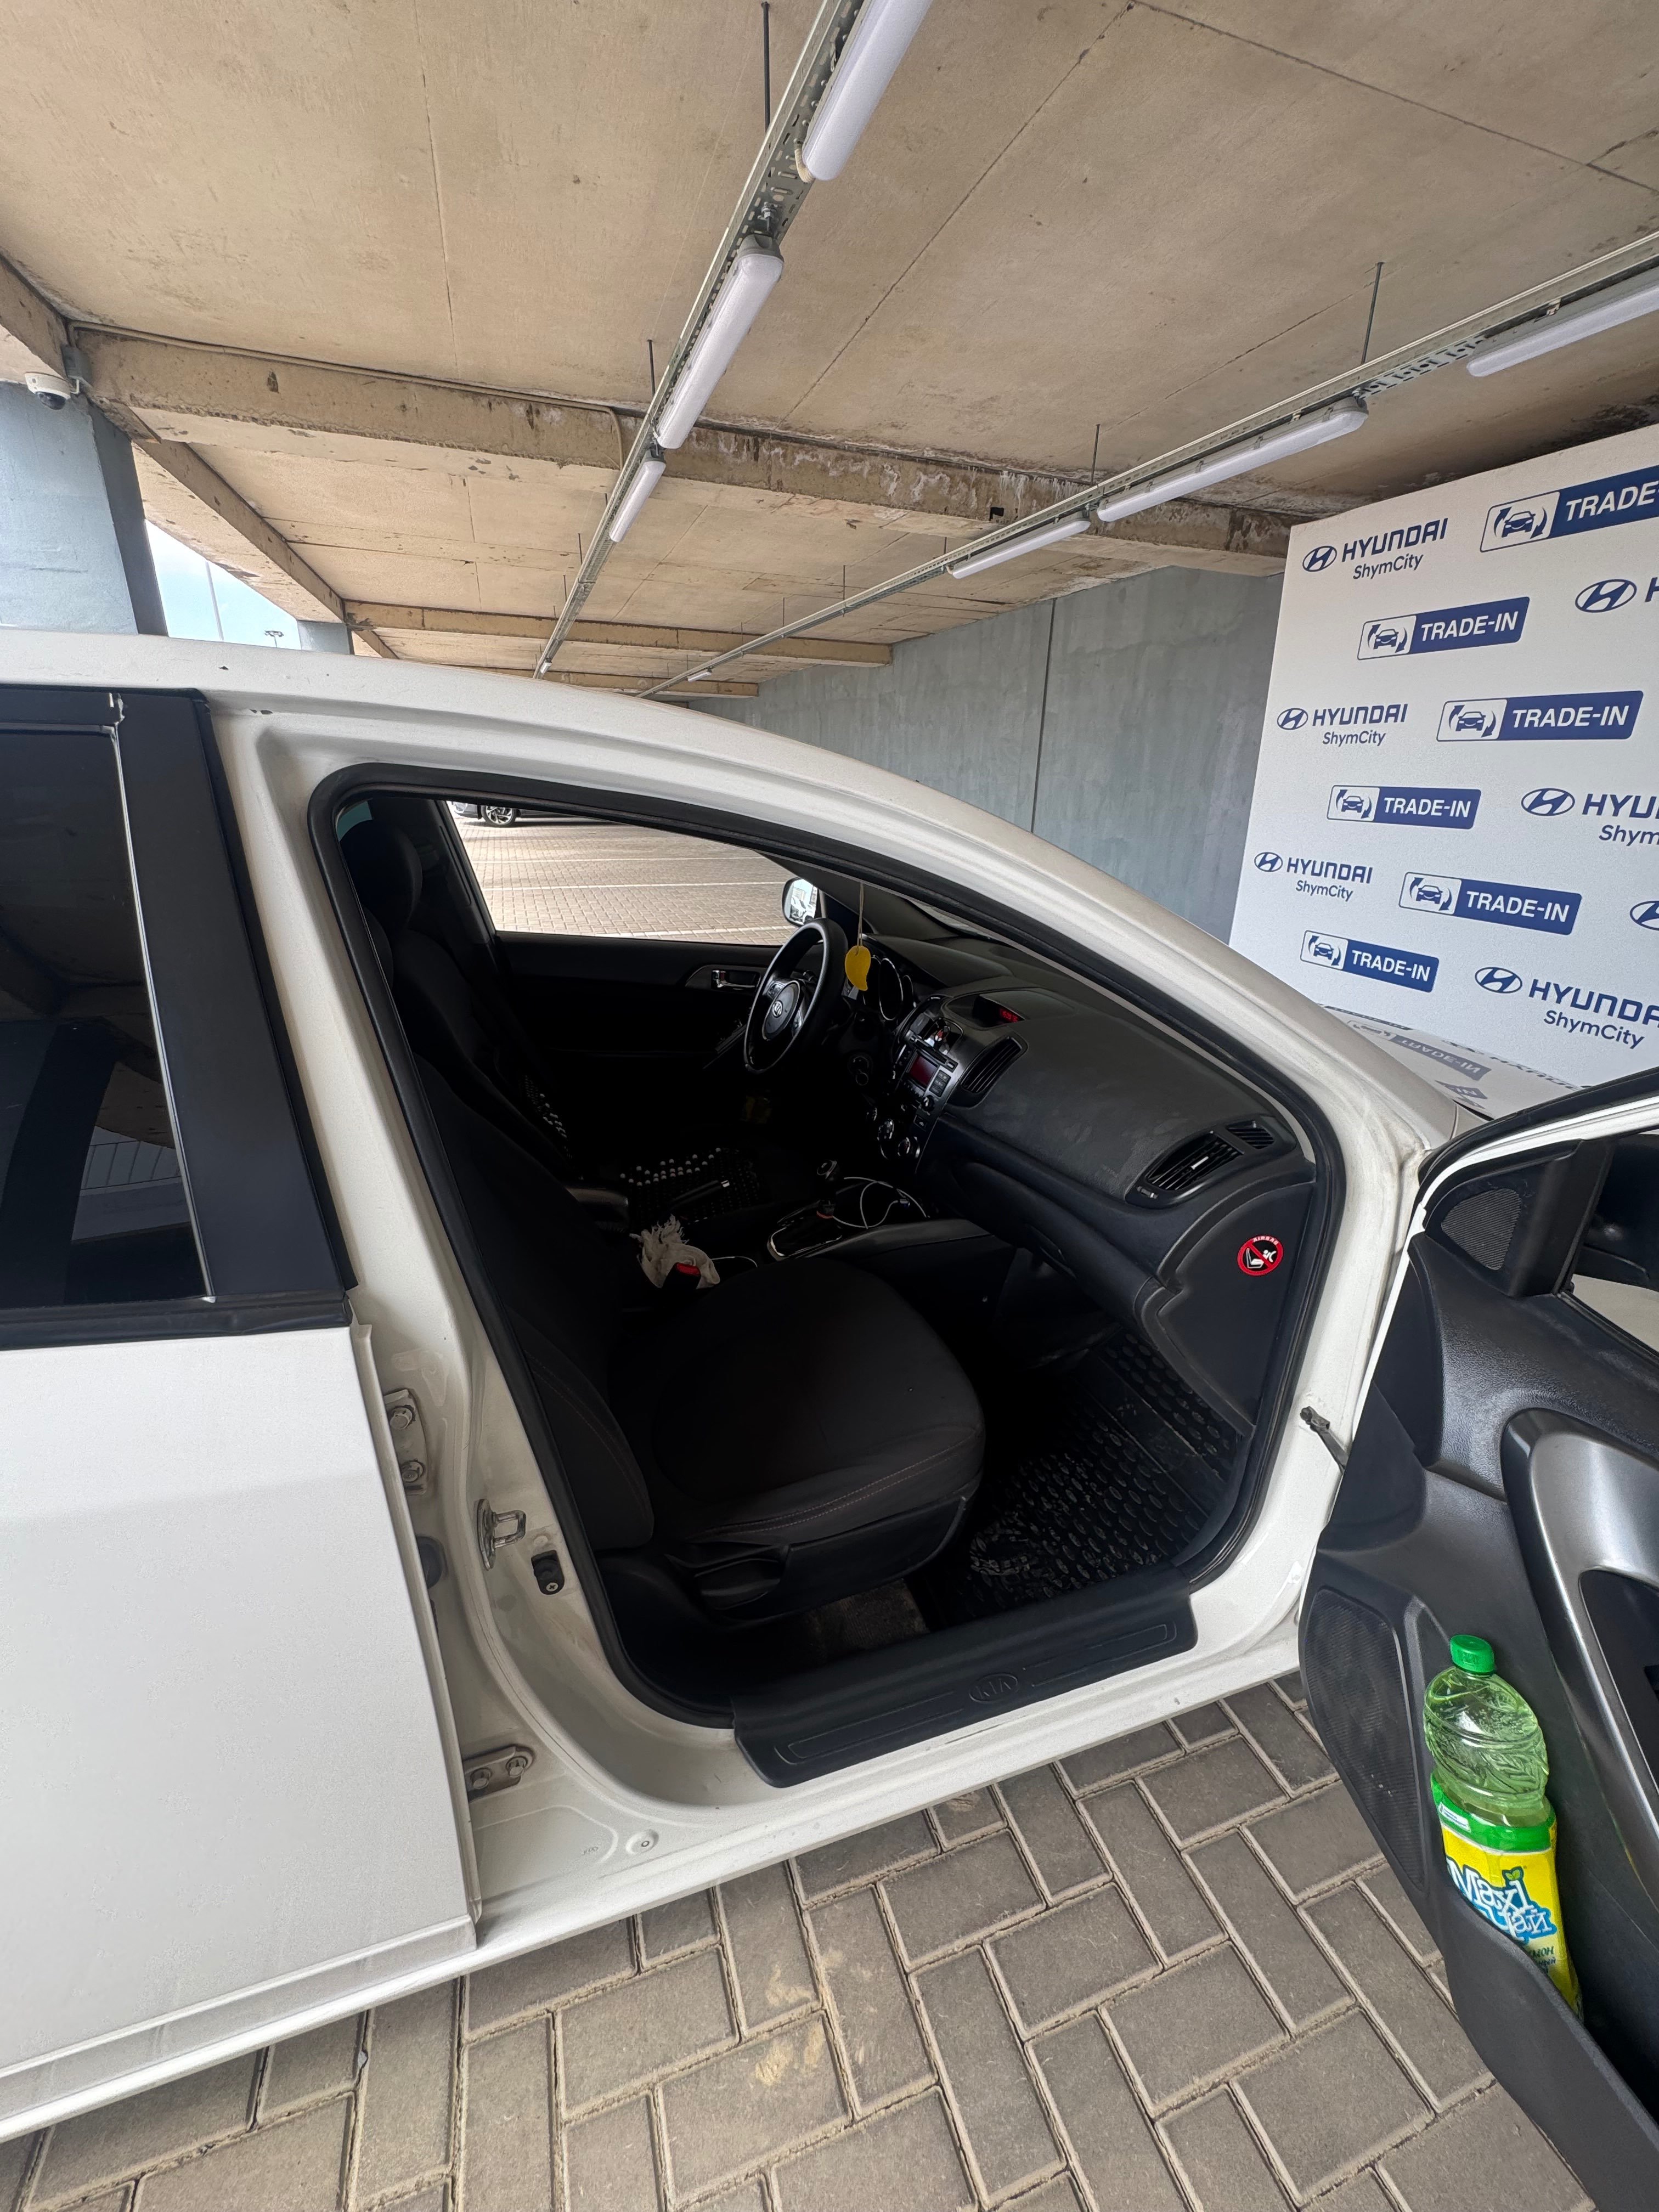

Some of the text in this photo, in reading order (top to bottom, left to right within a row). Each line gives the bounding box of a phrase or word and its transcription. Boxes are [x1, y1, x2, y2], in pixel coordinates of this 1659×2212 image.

[1566, 480, 1659, 521] TRADE
[1341, 517, 1448, 562] HYUNDAI
[1352, 554, 1424, 580] ShymCity
[1421, 611, 1519, 641] TRADE-IN
[1312, 703, 1408, 726] HYUNDAI
[1513, 706, 1629, 728] TRADE-IN
[1322, 730, 1386, 747] ShymCity
[1384, 797, 1471, 818] TRADE-IN
[1582, 793, 1659, 820] HYU
[1286, 857, 1373, 884] HYUNDAI
[1295, 879, 1353, 902] ShymCity
[1466, 890, 1570, 922] TRADE-IN
[1352, 950, 1430, 981] TRADE-IN
[1543, 1010, 1645, 1049] ShymCity
